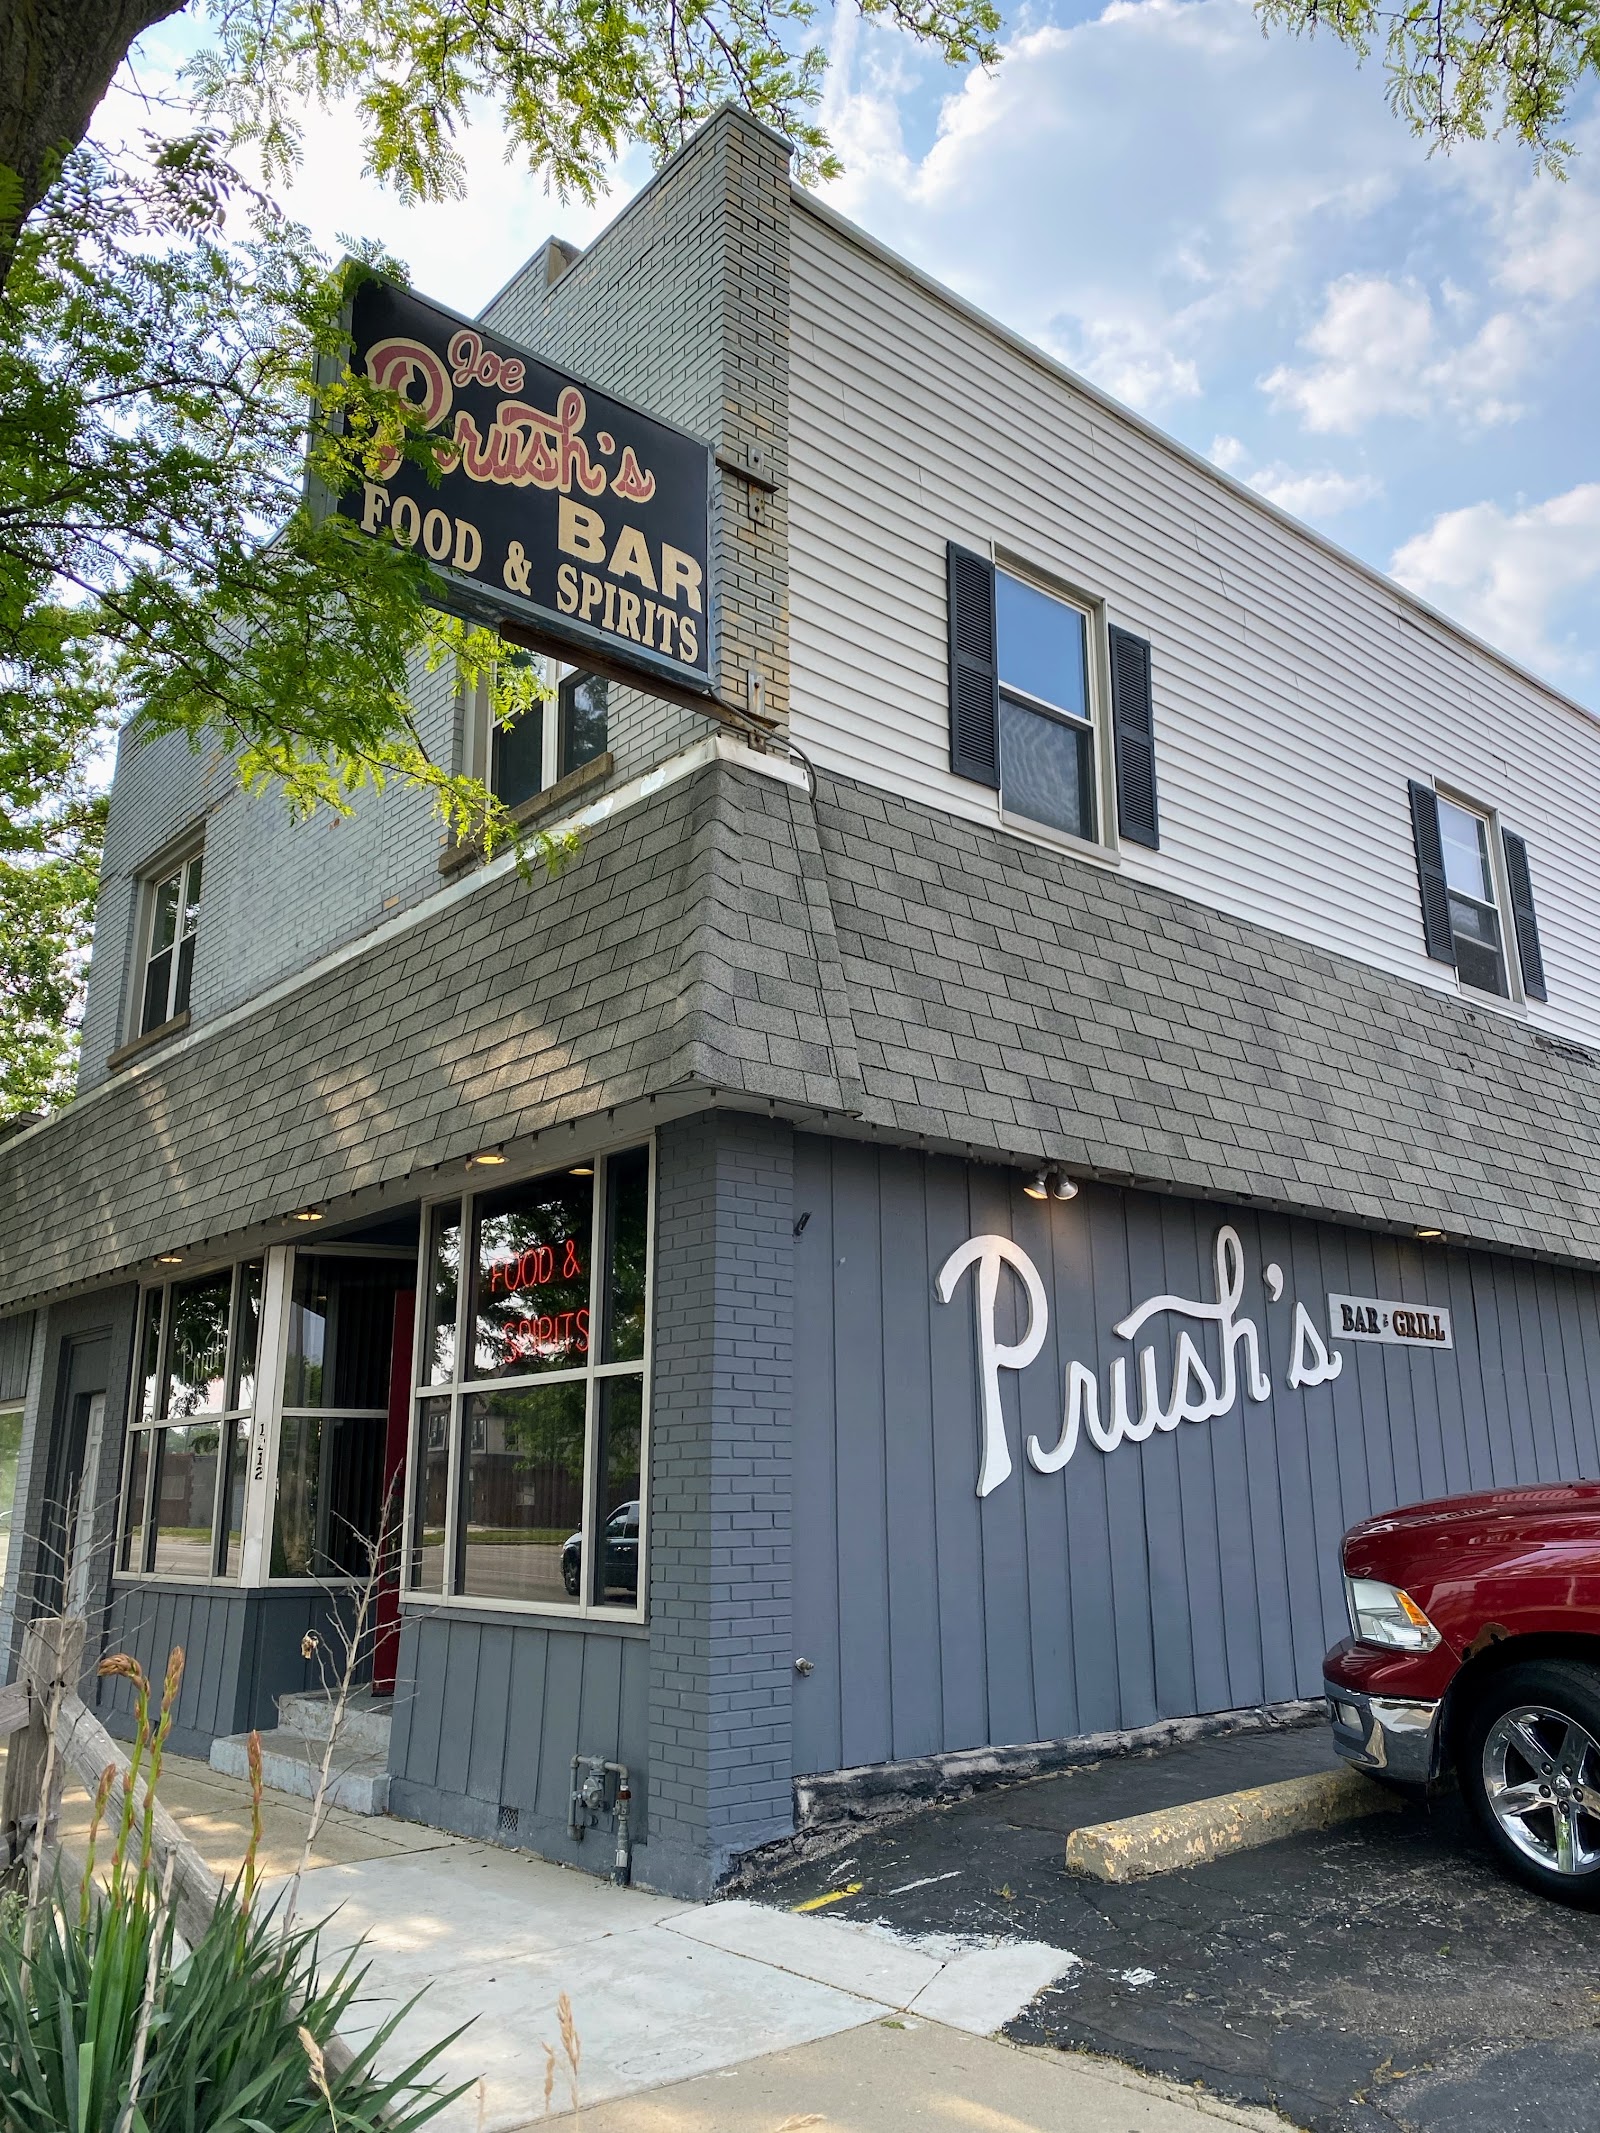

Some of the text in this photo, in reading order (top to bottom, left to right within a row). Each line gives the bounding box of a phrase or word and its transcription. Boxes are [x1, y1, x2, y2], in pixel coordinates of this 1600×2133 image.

[448, 330, 526, 393] Joe
[364, 337, 656, 502] Prush's
[361, 483, 698, 664] FOOD & SPIRITS
[558, 496, 703, 613] BAR
[490, 1240, 580, 1292] FOOD &
[503, 1309, 589, 1362] SPIRITS
[935, 1225, 1343, 1497] Prush's
[1341, 1304, 1381, 1333] BAR
[1392, 1310, 1446, 1341] GRILL
